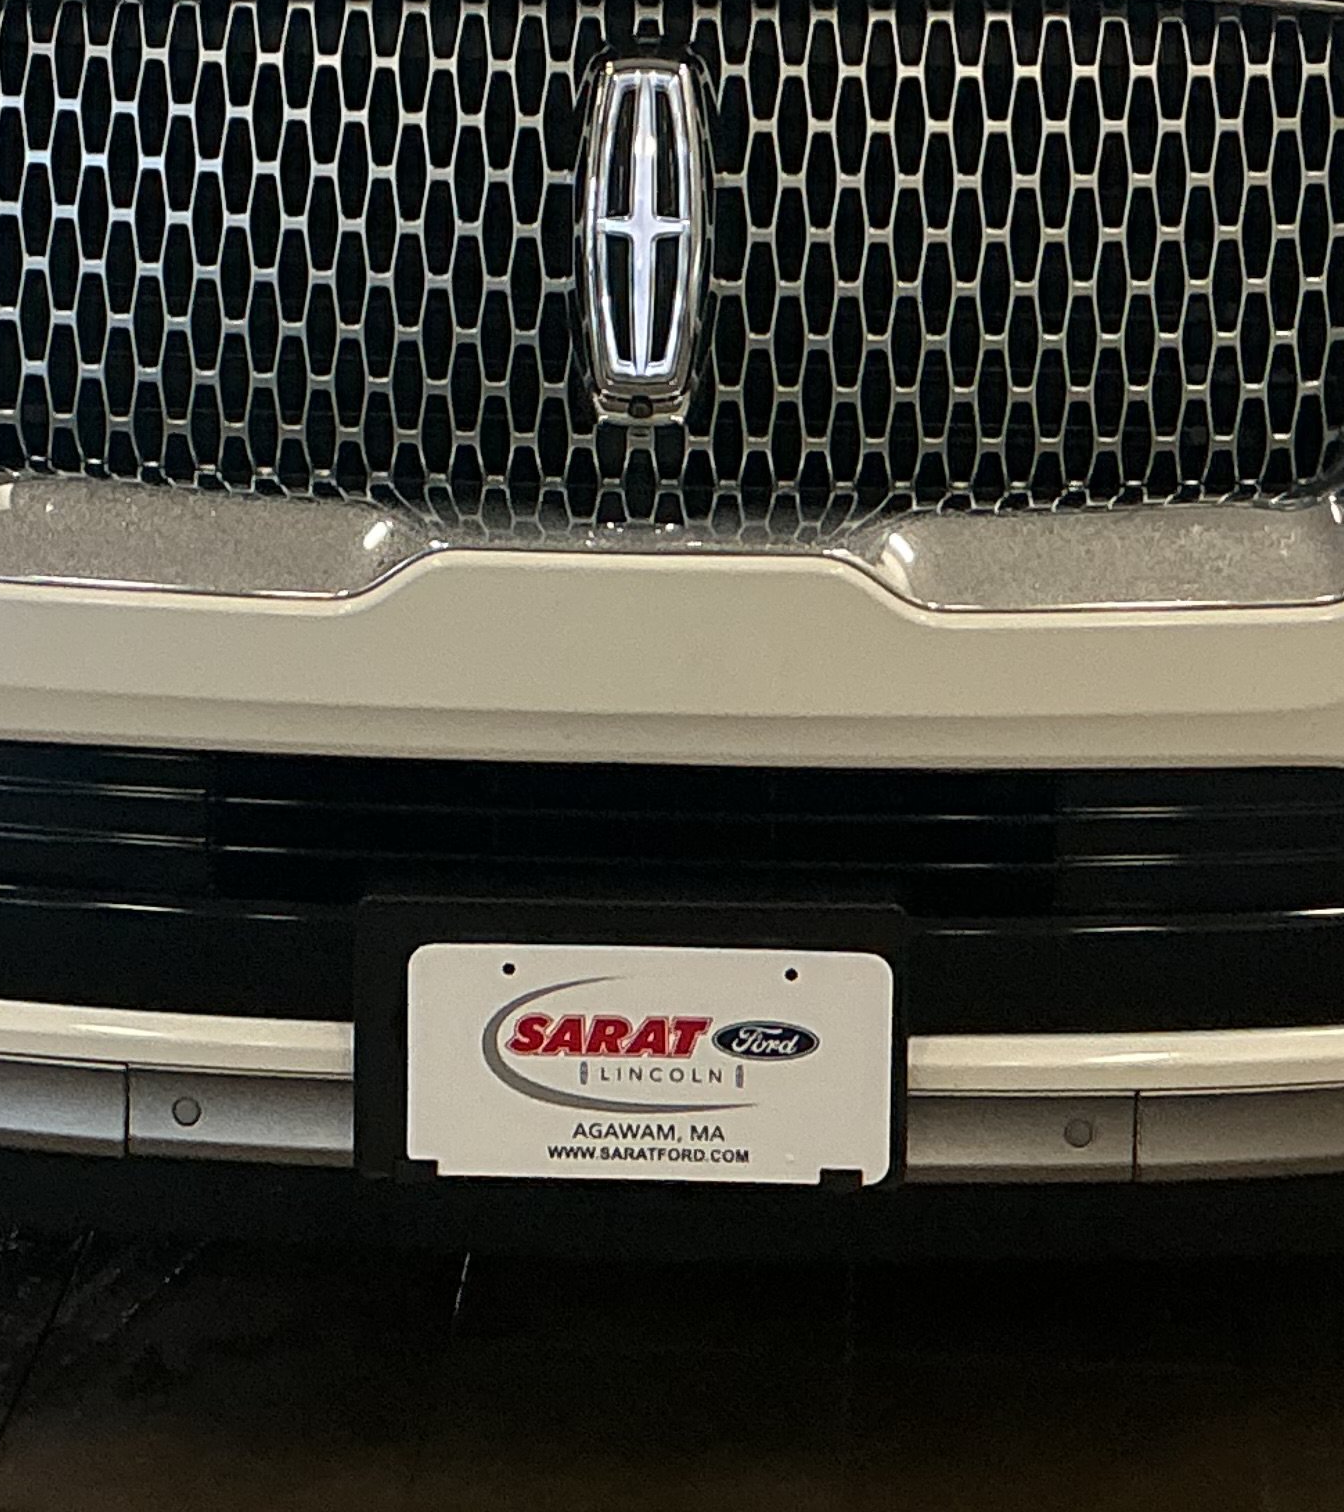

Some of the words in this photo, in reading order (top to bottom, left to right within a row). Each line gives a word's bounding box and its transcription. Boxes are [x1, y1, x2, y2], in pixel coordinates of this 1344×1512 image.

[507, 1012, 713, 1058] SARAT
[731, 1026, 798, 1054] Ford
[600, 1066, 723, 1084] LINCOLN
[572, 1122, 682, 1144] AGAWAM,
[690, 1124, 725, 1142] MA
[547, 1145, 749, 1163] WWW.SARATFORD.COM
